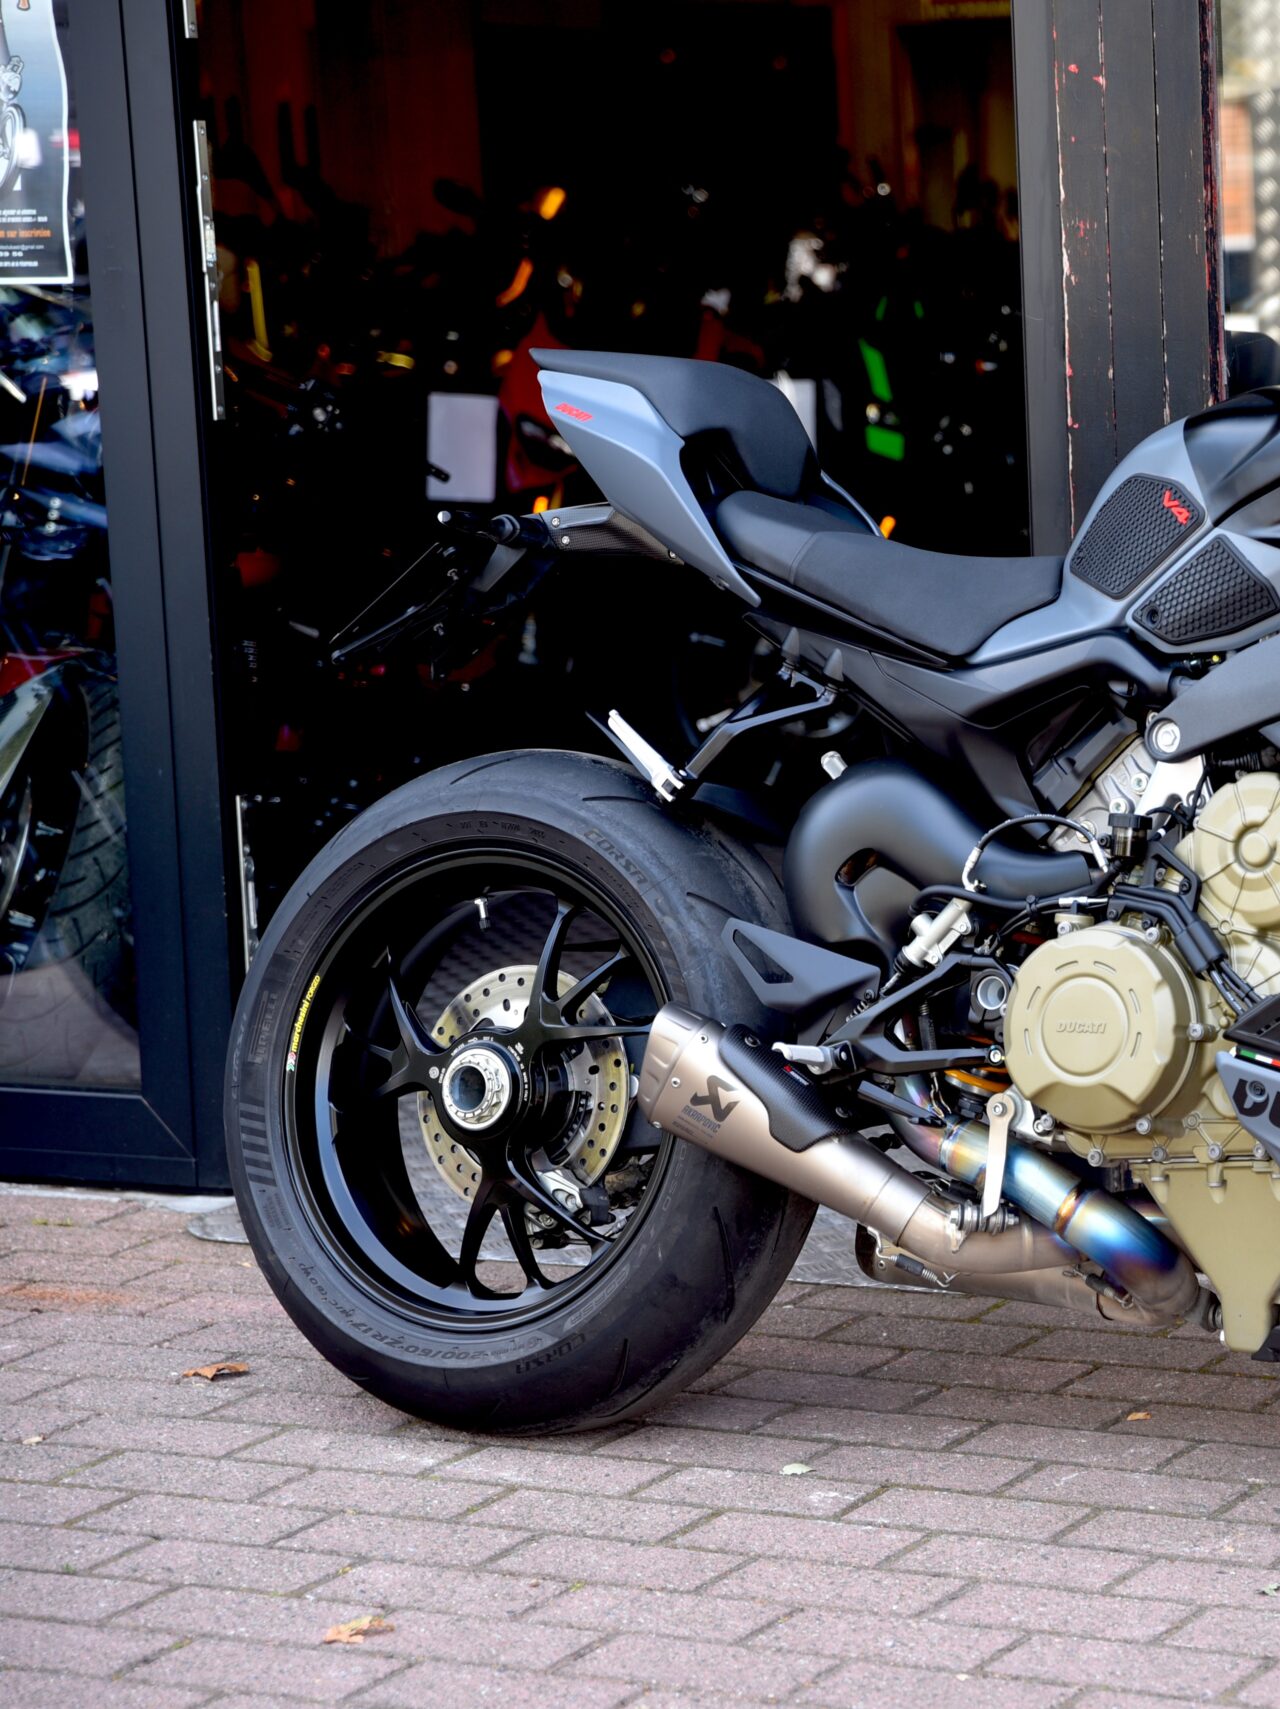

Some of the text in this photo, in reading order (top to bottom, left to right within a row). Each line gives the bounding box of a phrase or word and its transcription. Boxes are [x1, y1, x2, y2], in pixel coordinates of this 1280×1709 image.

[1162, 489, 1190, 526] V4
[584, 829, 648, 884] CORSA
[1056, 1021, 1107, 1034] DUCATI
